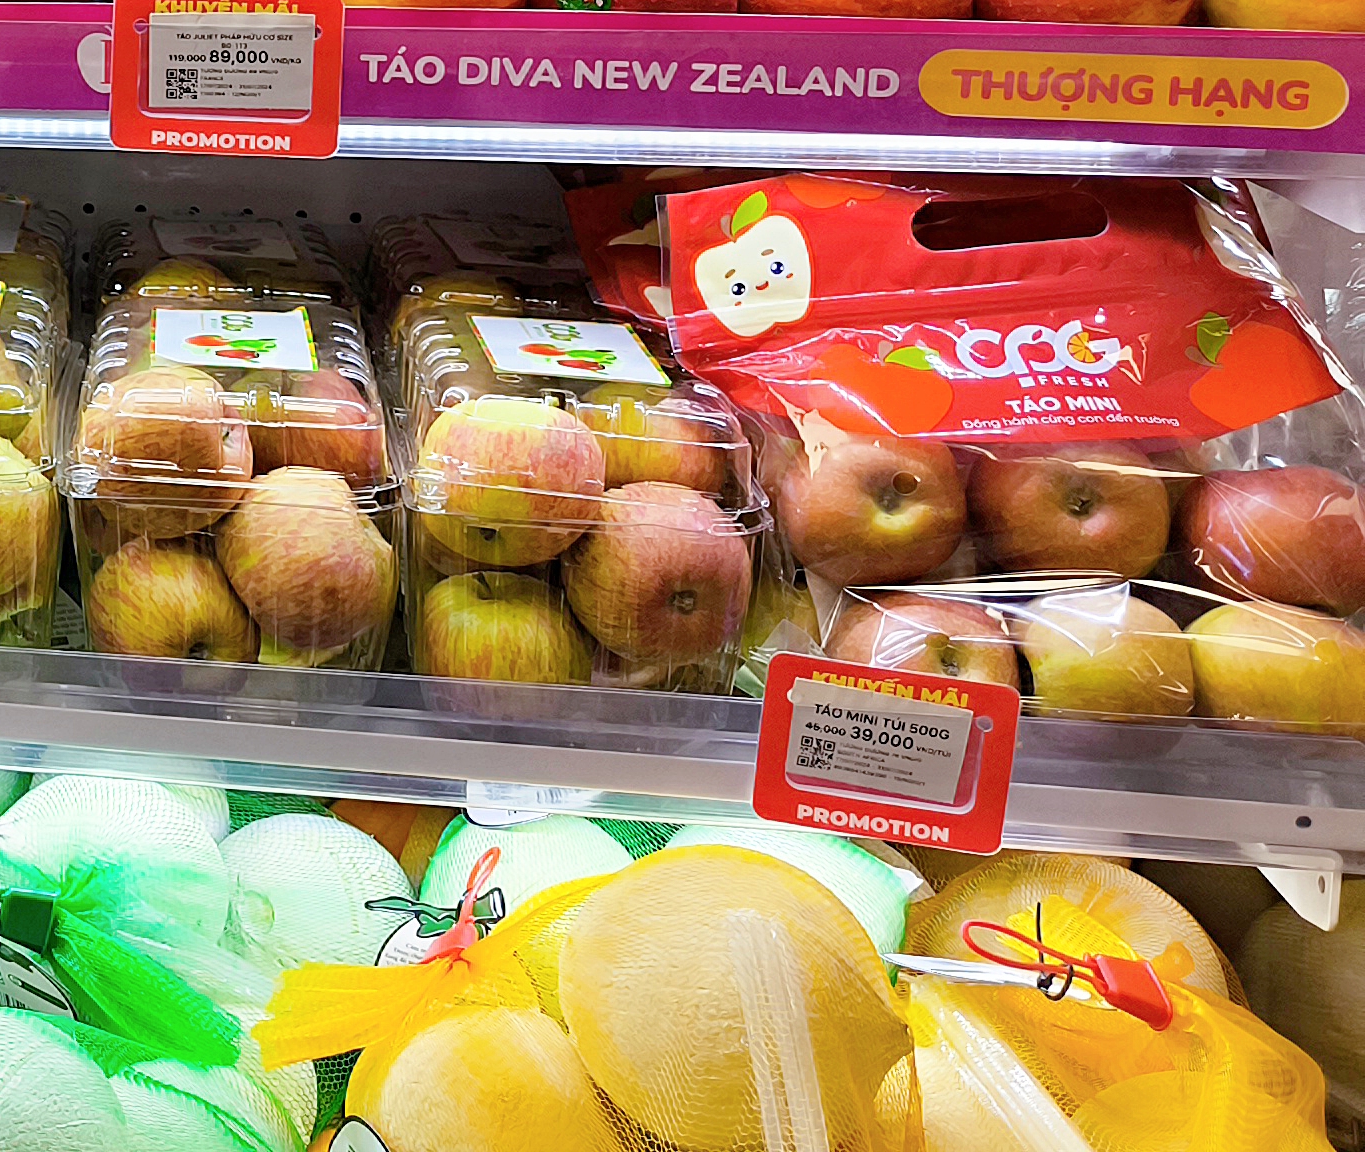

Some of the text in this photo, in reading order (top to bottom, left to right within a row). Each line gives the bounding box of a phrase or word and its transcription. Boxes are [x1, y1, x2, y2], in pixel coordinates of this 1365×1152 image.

[255, 0, 299, 14] MÃI
[209, 50, 269, 65] 89,000
[360, 47, 1309, 118] TÁO DIVA NEW ZEALAND THƯỢNG HẠNG
[151, 130, 291, 151] PROMOTION
[1039, 375, 1109, 388] FRESH
[1006, 395, 1121, 414] TÁO MINI
[962, 418, 1001, 429] Đồng
[1004, 415, 1038, 426] hành
[1041, 414, 1075, 426] cùng
[1078, 415, 1103, 423] con
[812, 671, 968, 708] KHUYẾN MÃI
[815, 703, 950, 740] TÁO MINI TÚI 500G
[850, 726, 914, 749] 39,000
[797, 804, 949, 843] PROMOTION
